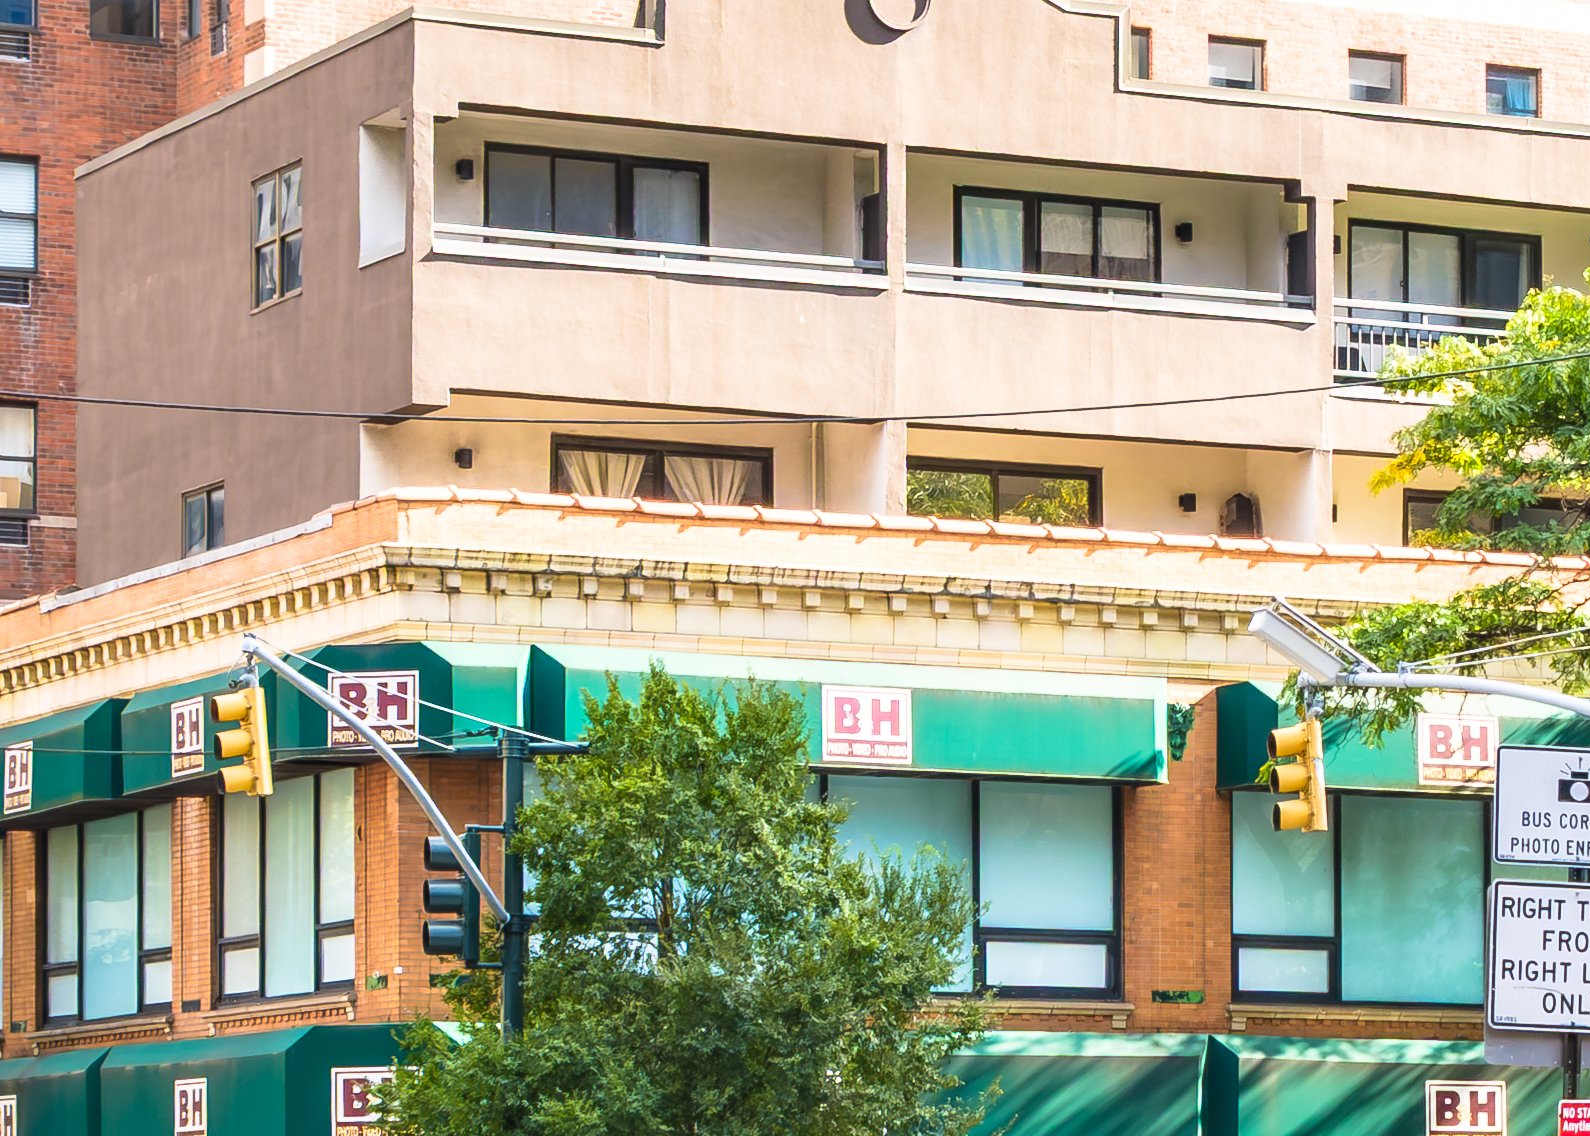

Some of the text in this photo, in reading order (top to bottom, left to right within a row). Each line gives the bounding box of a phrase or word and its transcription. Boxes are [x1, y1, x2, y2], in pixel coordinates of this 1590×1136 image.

[1521, 811, 1551, 828] BUS
[1511, 837, 1560, 855] PHOTO
[1502, 896, 1566, 921] RIGHT
[1502, 959, 1572, 983] RIGHT
[1562, 1107, 1576, 1119] NO
